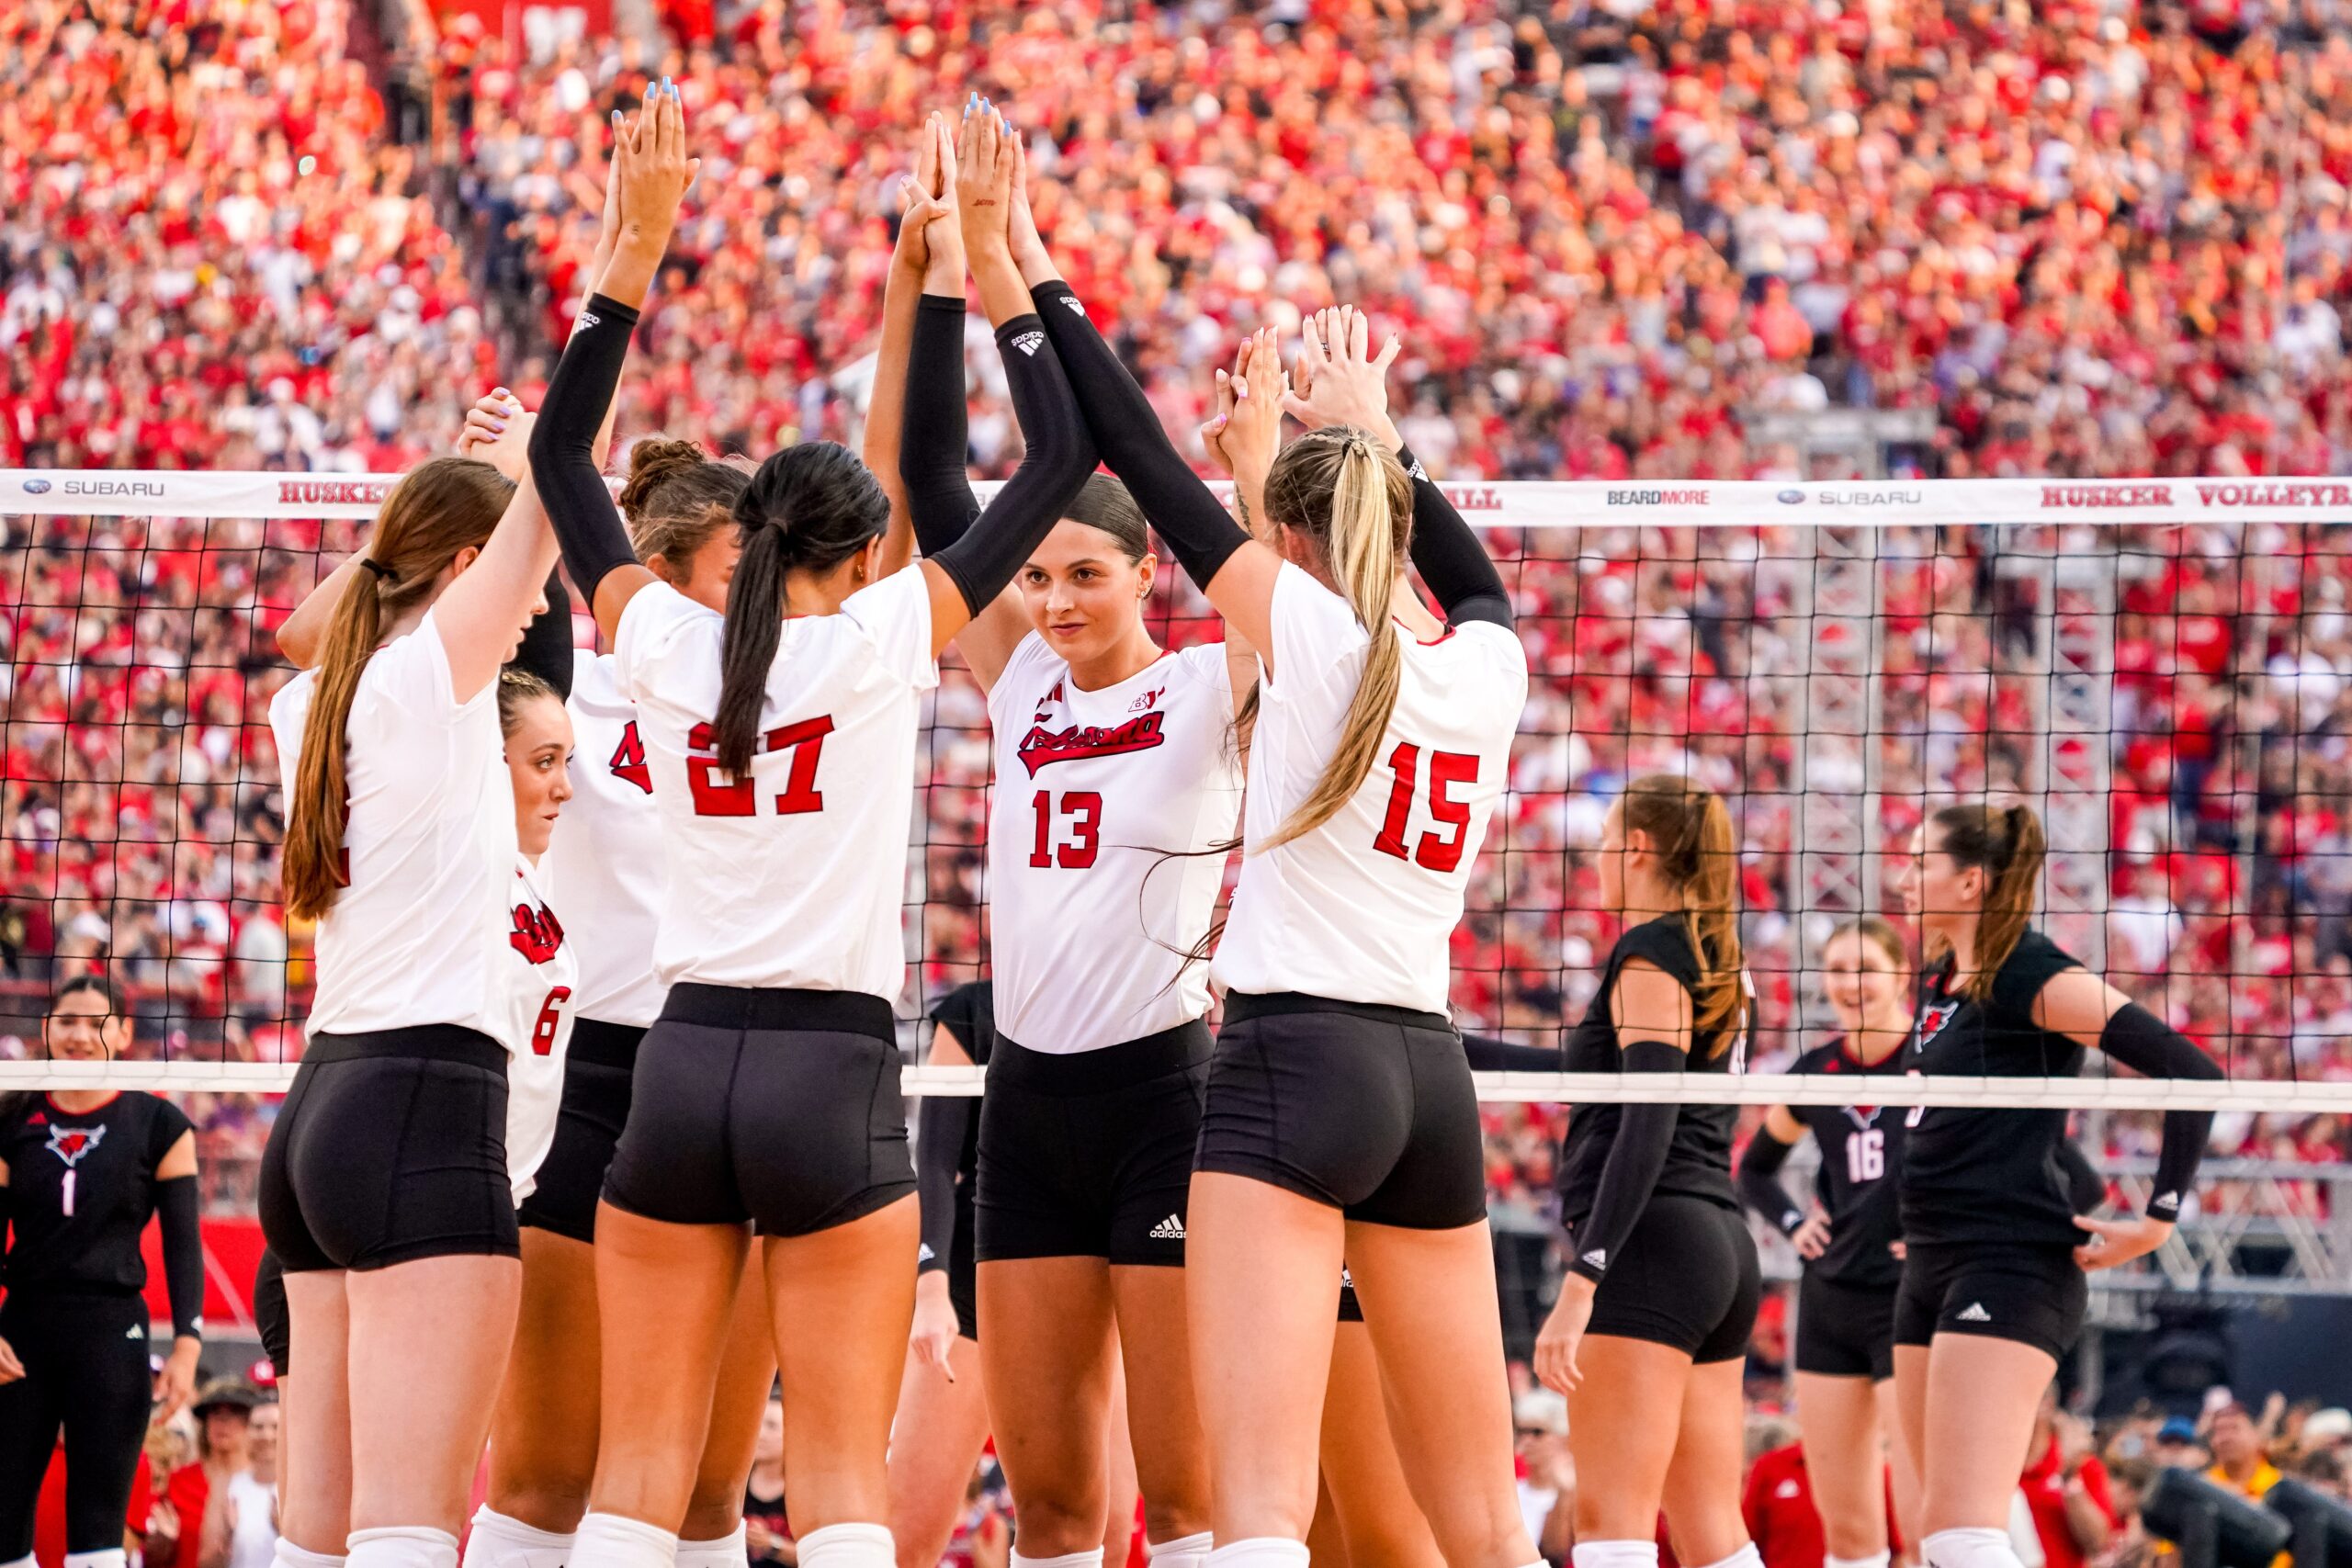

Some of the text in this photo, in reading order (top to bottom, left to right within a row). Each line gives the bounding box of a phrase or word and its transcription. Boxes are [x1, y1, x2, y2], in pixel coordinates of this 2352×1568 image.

[1012, 331, 1045, 348] adidas
[64, 480, 164, 496] SUBARU
[1608, 490, 1711, 505] BEARDMORE
[1819, 491, 1923, 505] SUBARU
[2041, 484, 2352, 507] HUSKER VOLLEYB
[685, 713, 835, 817] 27
[1373, 741, 1480, 874] 15
[1029, 789, 1103, 869] 13
[531, 986, 571, 1056] 6
[1846, 1129, 1884, 1183] 16
[62, 1168, 76, 1217] 1
[1149, 1229, 1187, 1239] adidas
